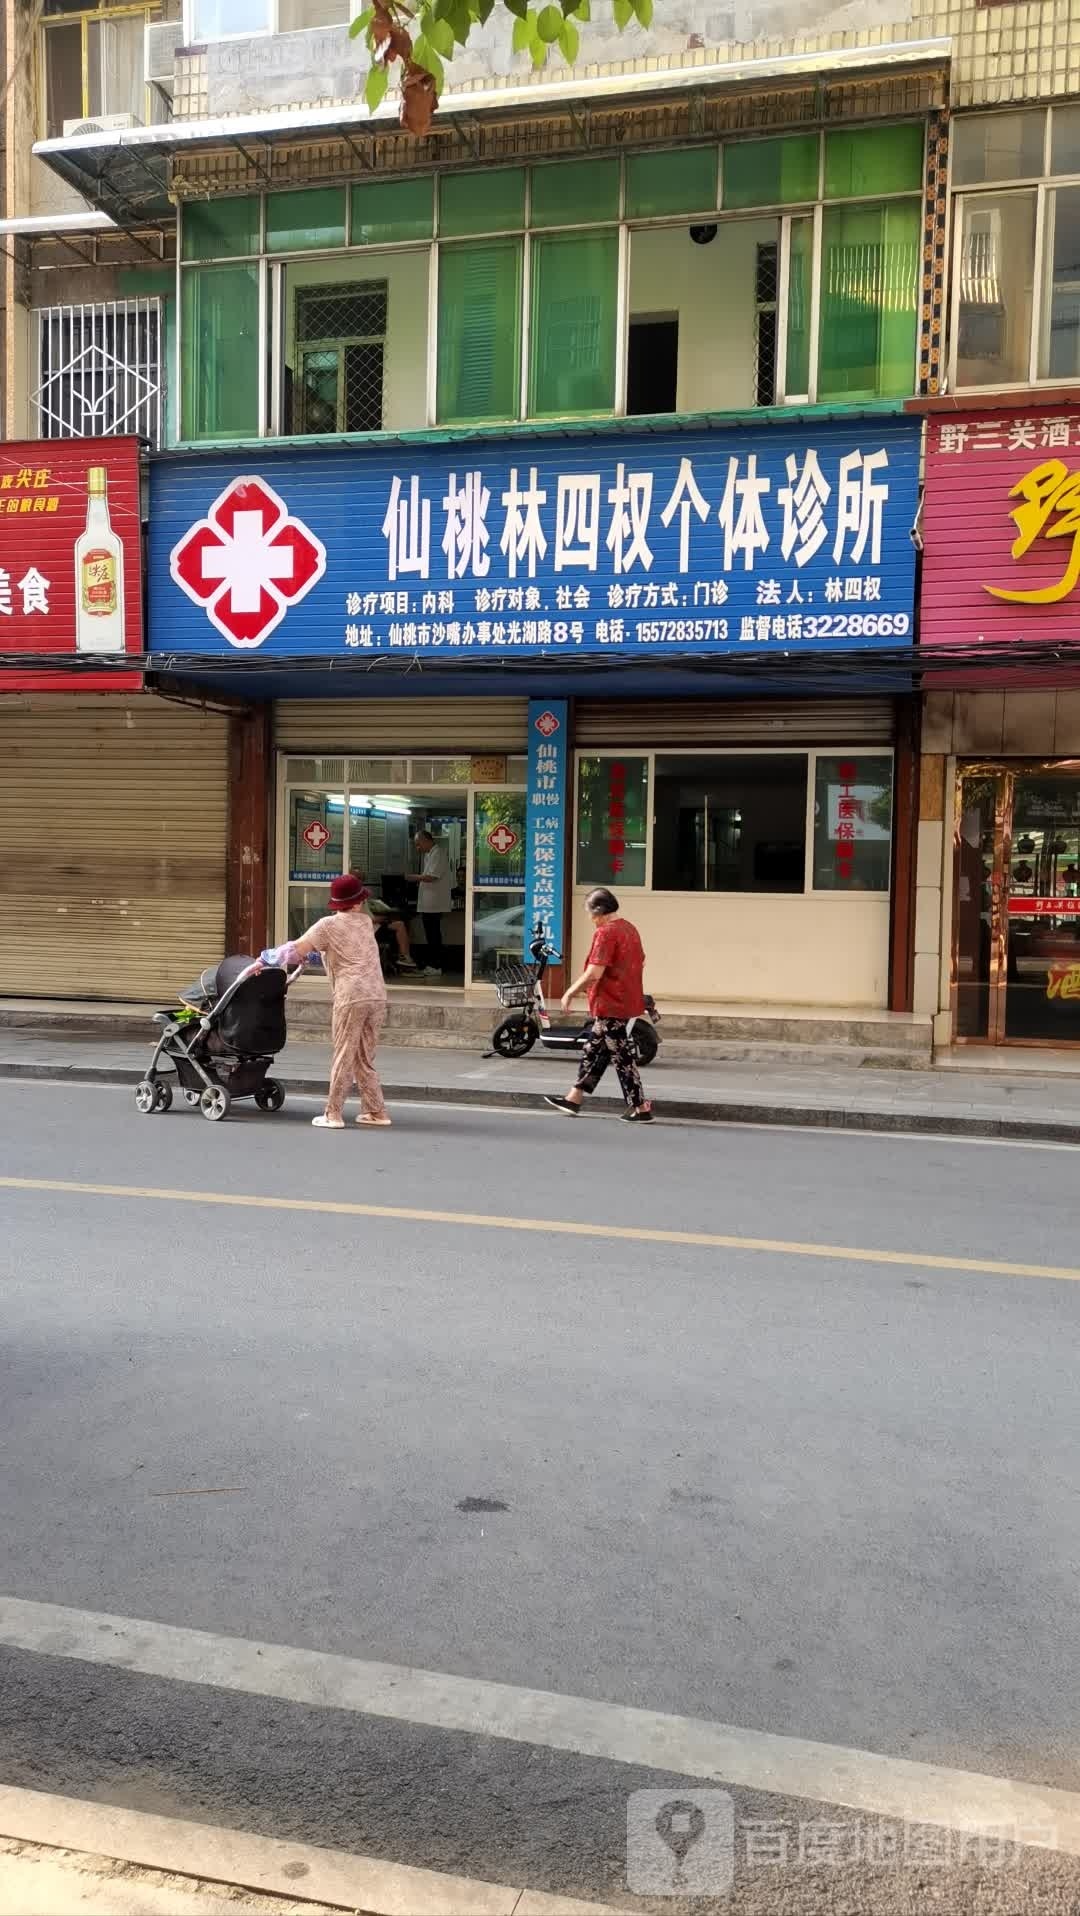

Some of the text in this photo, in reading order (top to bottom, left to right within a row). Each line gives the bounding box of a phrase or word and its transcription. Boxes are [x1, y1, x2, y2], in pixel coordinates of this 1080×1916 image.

[937, 417, 1080, 454] 野三关酒
[381, 448, 889, 581] 仙桃林四权个体诊所
[738, 612, 910, 642] 监督电话3228669
